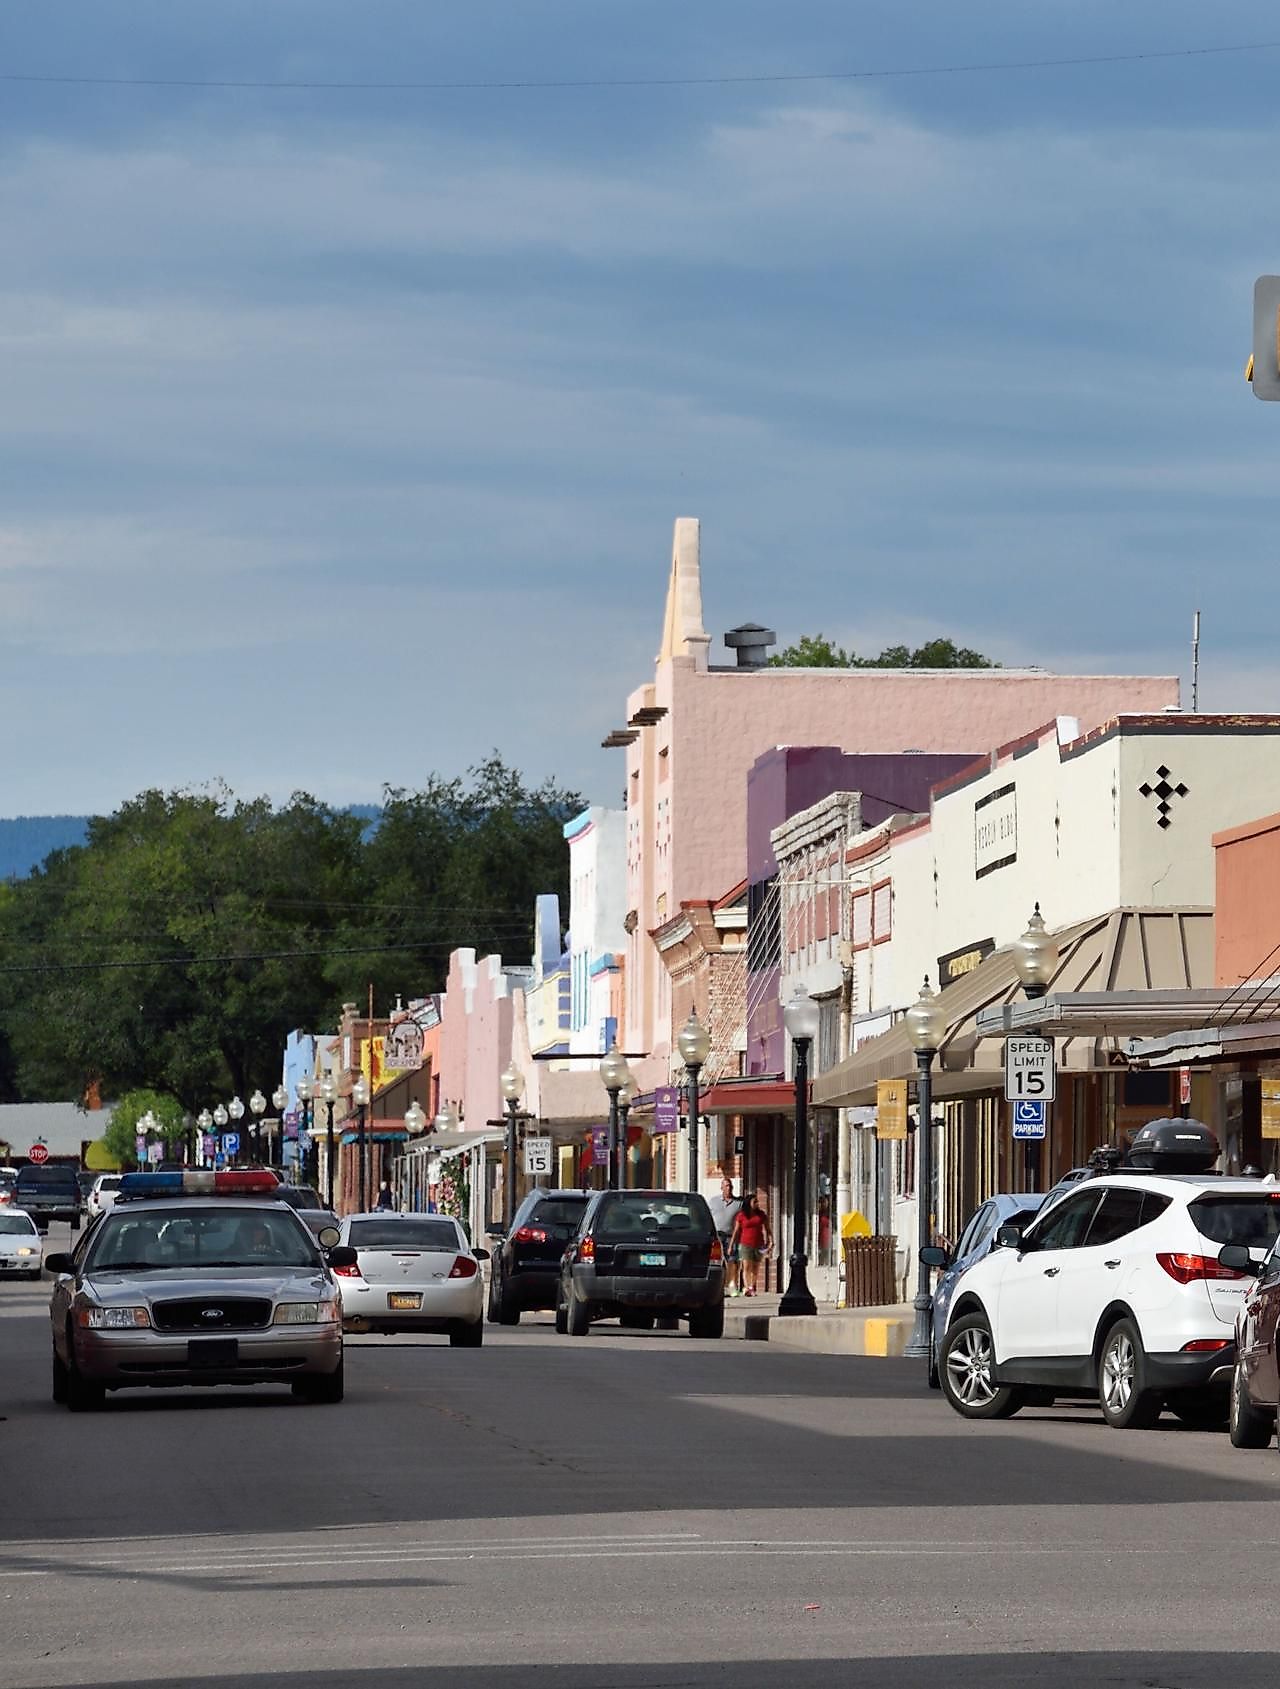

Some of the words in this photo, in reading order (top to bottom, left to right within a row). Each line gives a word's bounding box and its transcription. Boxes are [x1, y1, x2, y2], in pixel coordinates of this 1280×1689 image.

[1010, 1043, 1051, 1053] SPEED
[1014, 1056, 1047, 1067] LIMIT
[1015, 1071, 1046, 1095] 15
[1015, 1123, 1044, 1134] PARKING
[31, 1148, 48, 1160] STOP
[529, 1158, 546, 1170] 15
